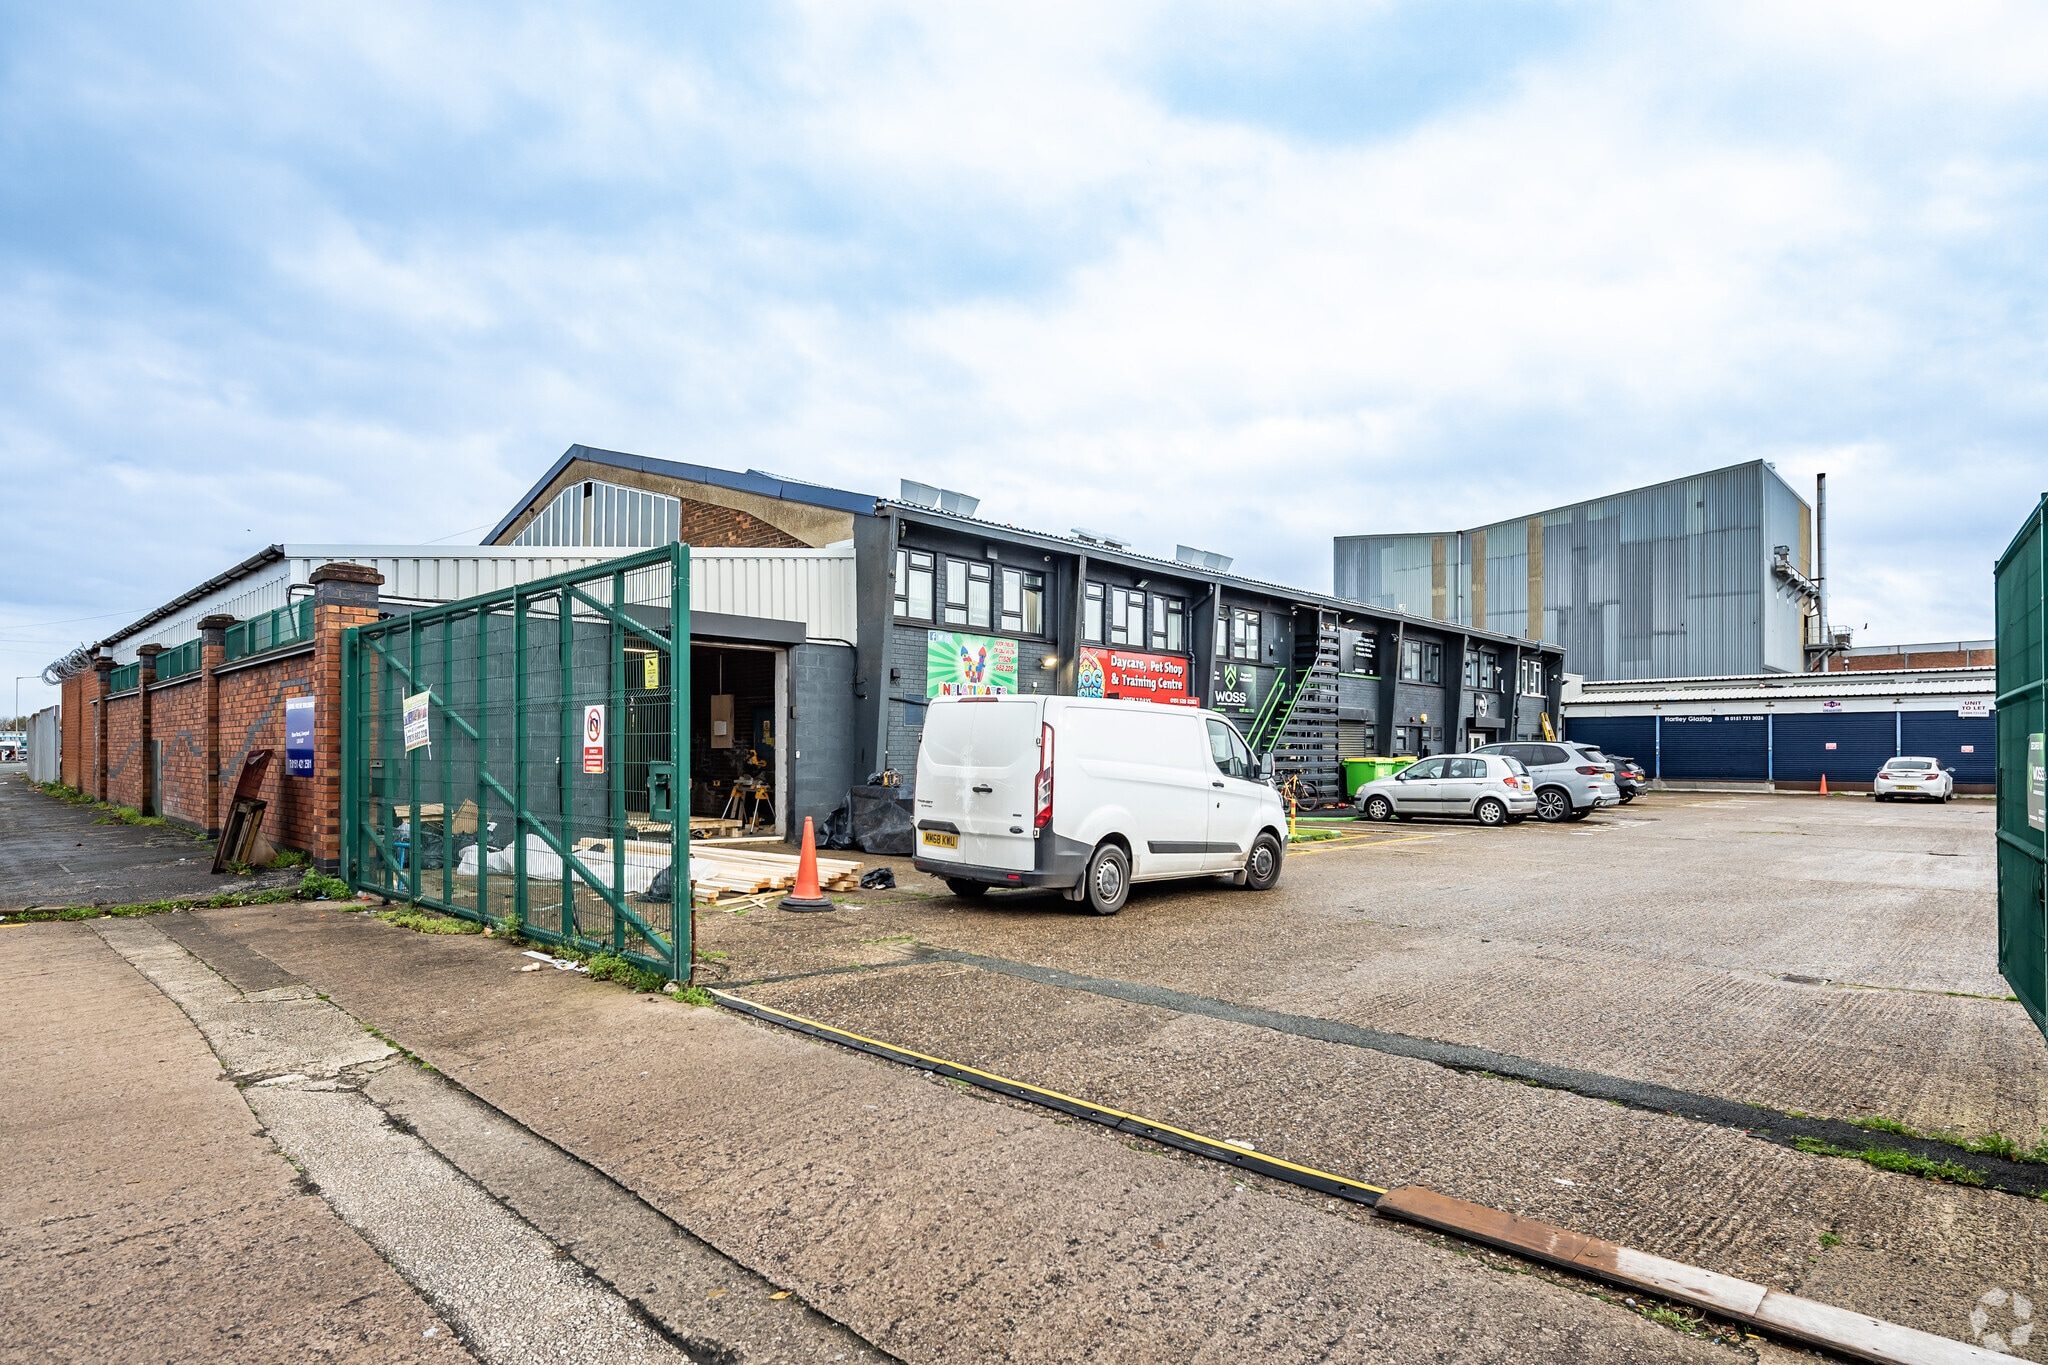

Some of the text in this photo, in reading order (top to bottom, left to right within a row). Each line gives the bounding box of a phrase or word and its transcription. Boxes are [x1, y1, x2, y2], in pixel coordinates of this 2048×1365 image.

[1111, 655, 1183, 677] Daycare, Pet Shop
[939, 683, 1006, 696] INFLATIMATES
[1111, 673, 1183, 692] & Training Centre
[1214, 690, 1247, 703] WOSS
[1688, 715, 1713, 723] Glazing
[925, 832, 955, 847] MM68 KWU
